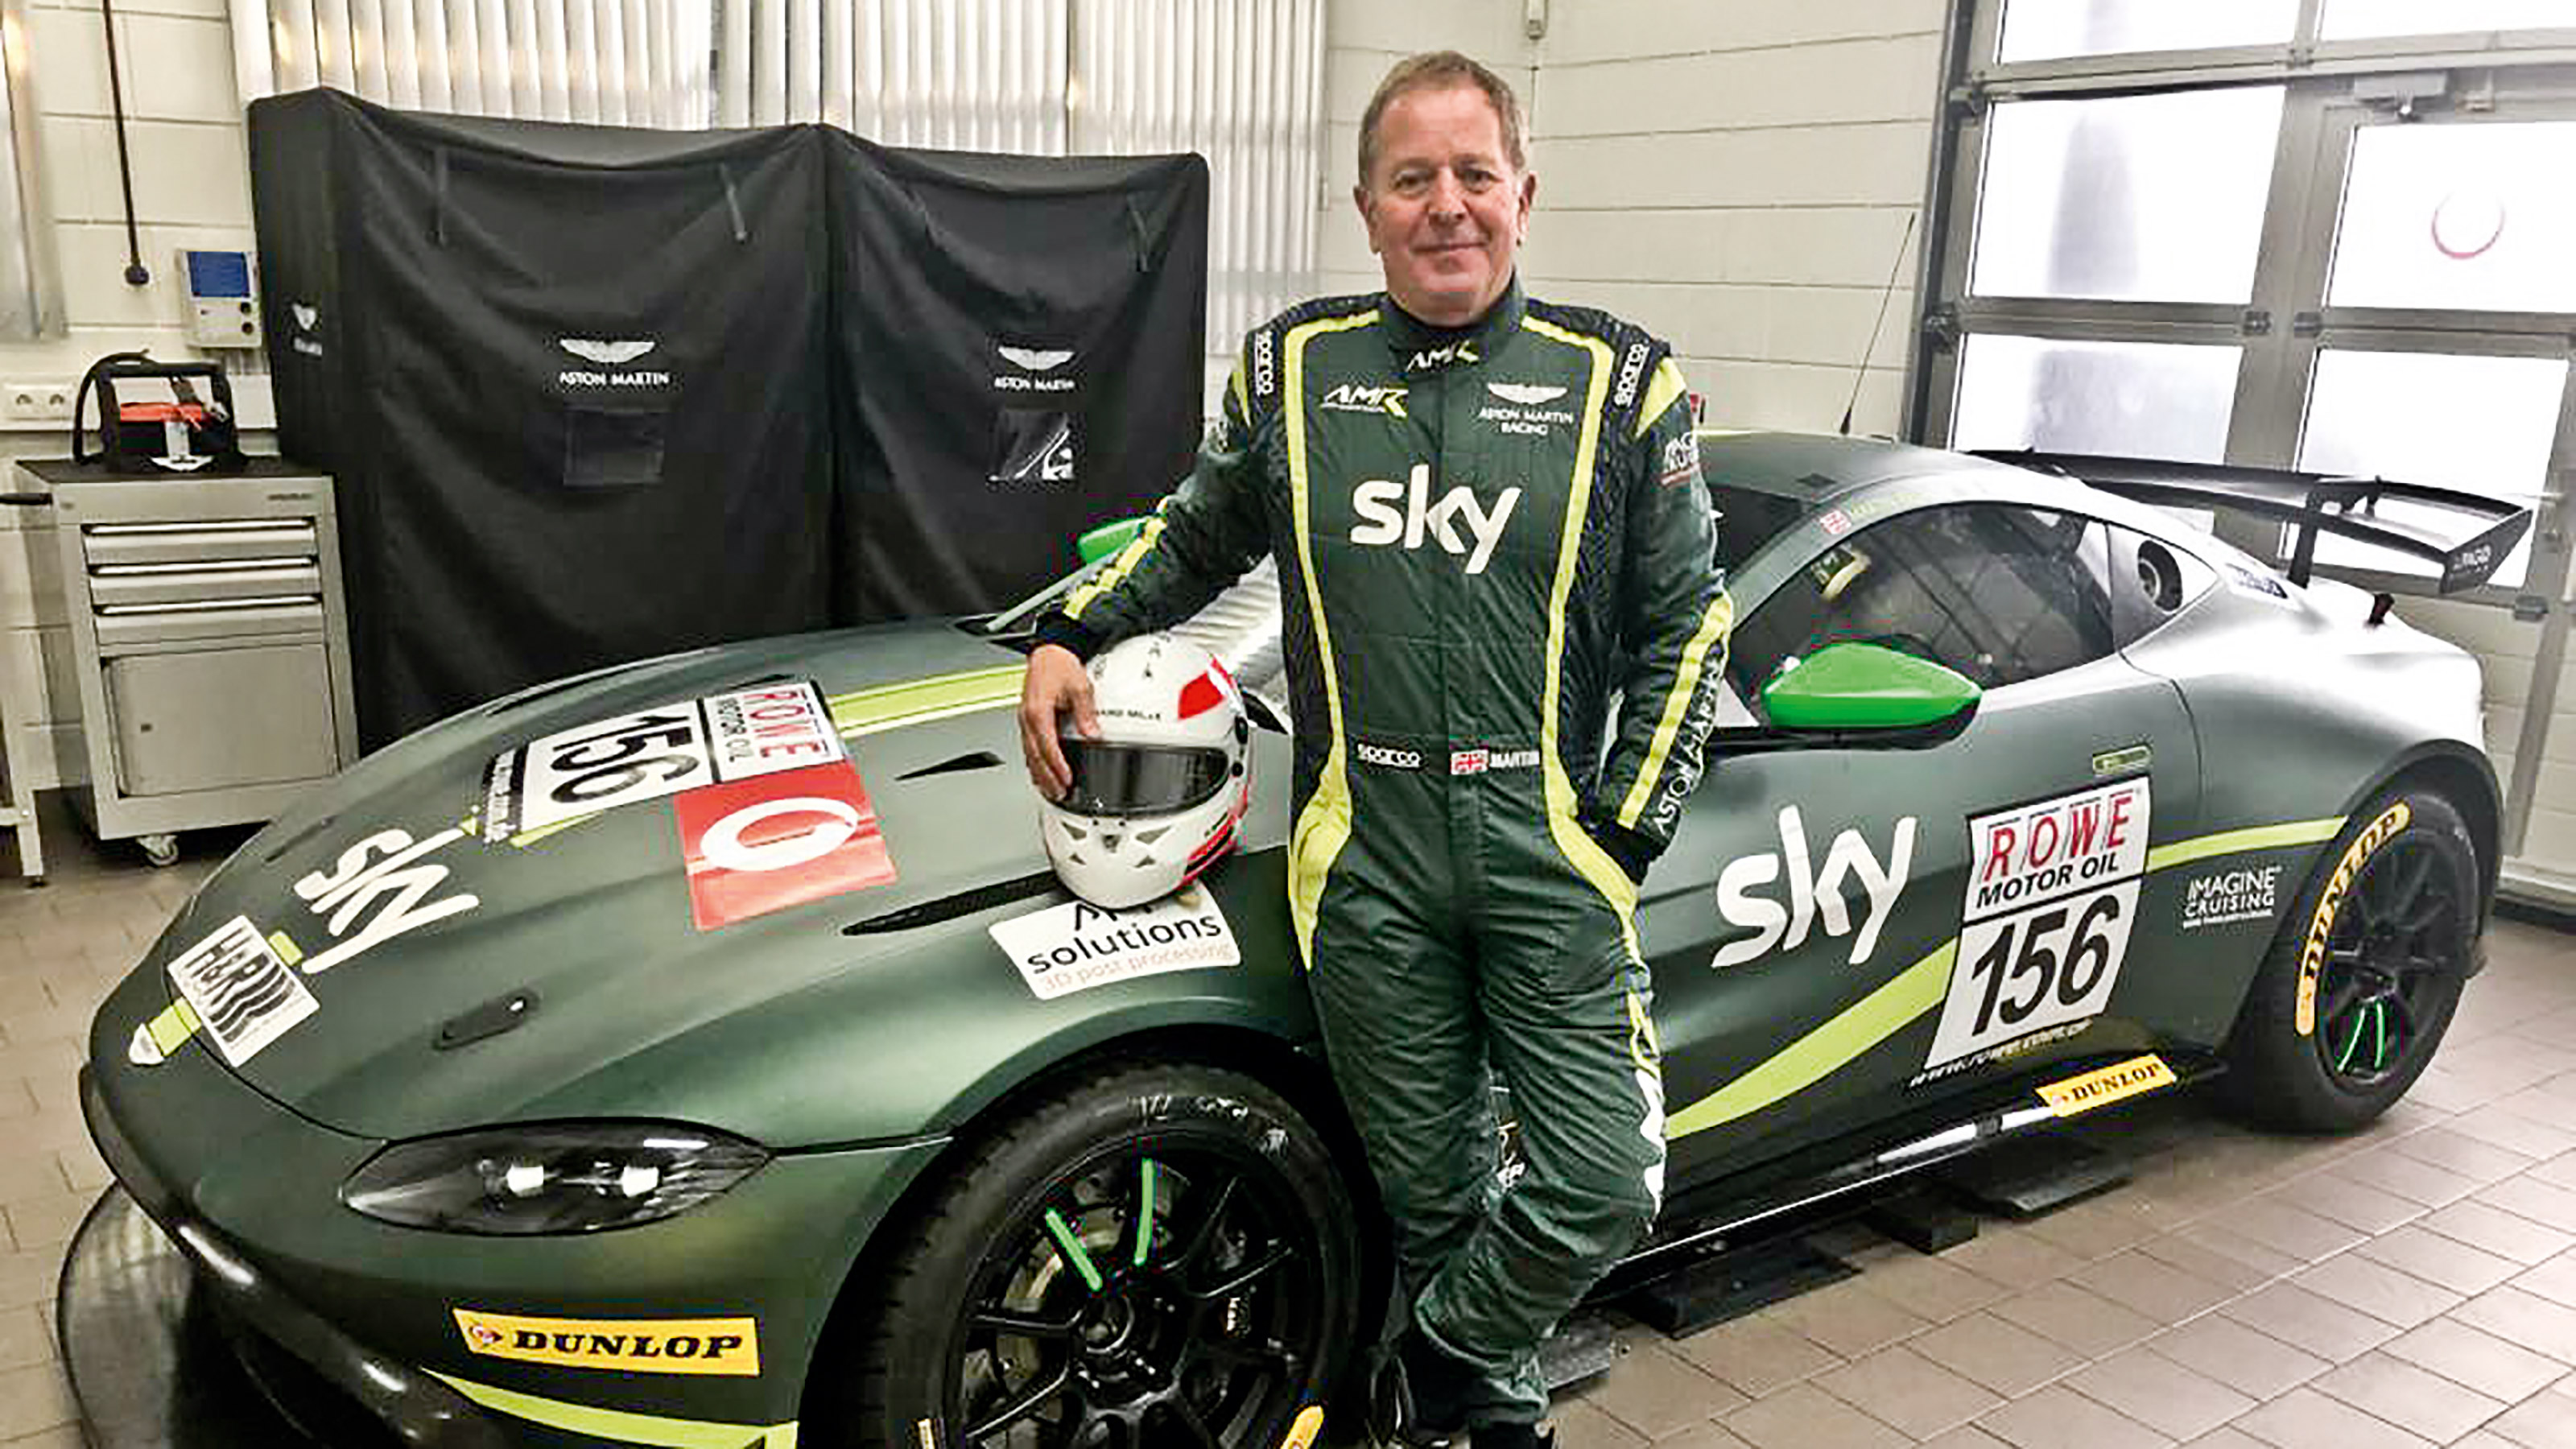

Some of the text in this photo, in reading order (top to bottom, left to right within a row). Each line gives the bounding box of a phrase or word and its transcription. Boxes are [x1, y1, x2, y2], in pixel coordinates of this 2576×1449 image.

[559, 371, 670, 386] ASTON MARTIN
[1614, 343, 1650, 407] sparco
[1525, 410, 1574, 423] MARTIN
[1350, 464, 1522, 574] sky
[742, 688, 821, 758] ROWE
[550, 714, 700, 804] 156
[1357, 743, 1421, 768] sparco
[1653, 756, 1693, 836] ASTON
[1984, 794, 2134, 881] ROWE
[295, 828, 480, 975] sky
[1711, 805, 1917, 968] sky
[1976, 851, 2120, 909] MOTOR OIL
[2185, 890, 2275, 917] CRUISING
[2187, 866, 2276, 902] IMAGINE
[1027, 914, 1222, 974] solutions
[1043, 940, 1233, 992] 3D post processing
[1971, 894, 2120, 1037] 156
[2071, 1061, 2163, 1102] DUNLOP
[512, 1329, 743, 1360] DUNLOP
